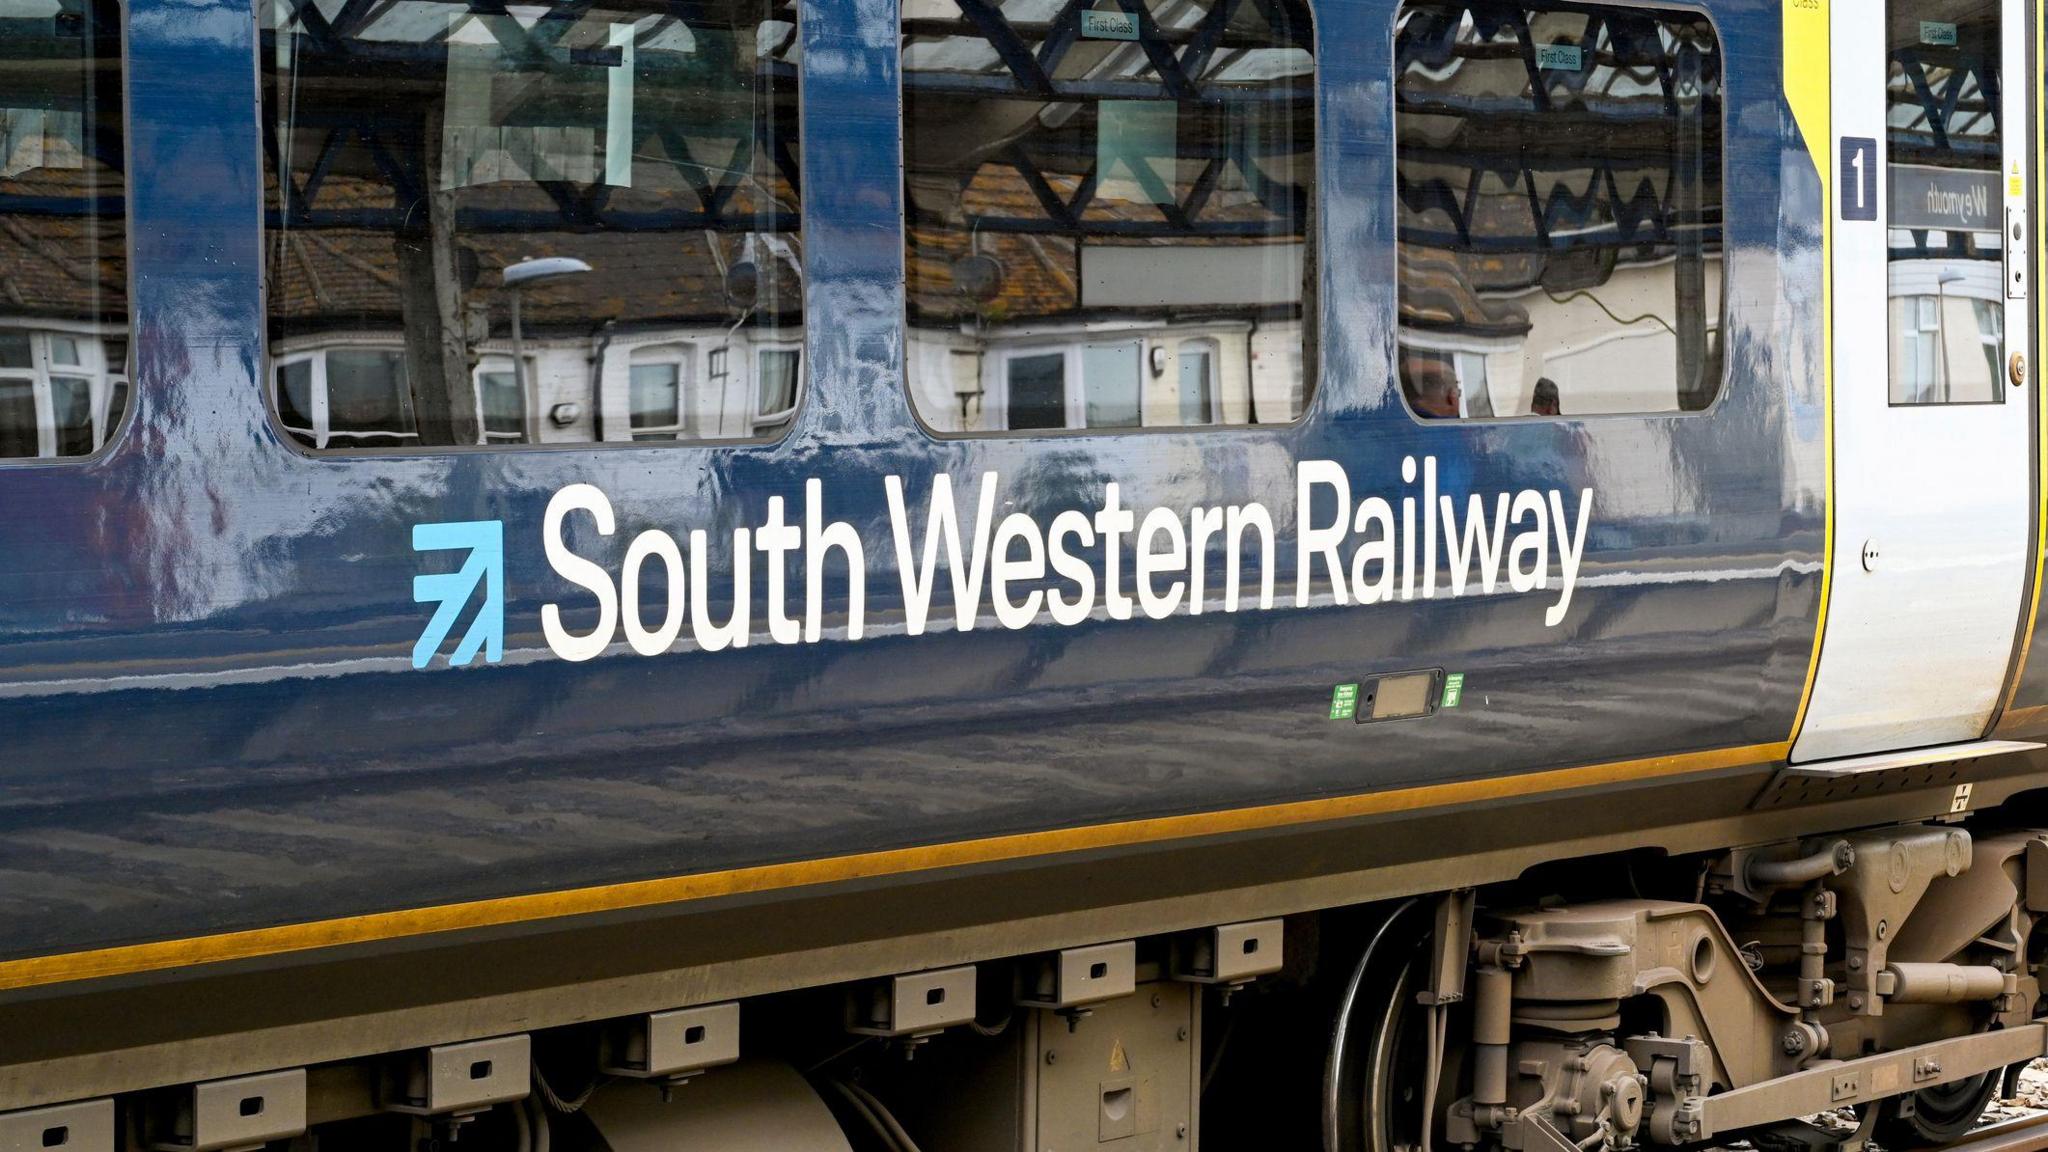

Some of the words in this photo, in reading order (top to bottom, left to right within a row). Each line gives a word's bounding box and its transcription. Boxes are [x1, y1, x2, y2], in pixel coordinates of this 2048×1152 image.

[1088, 15, 1108, 32] First
[1110, 17, 1133, 34] Class
[1541, 49, 1557, 63] First
[1558, 50, 1577, 65] Class
[1851, 147, 1864, 208] 1
[541, 477, 866, 663] South
[884, 471, 1275, 637] Western
[1296, 455, 1594, 627] Railway
